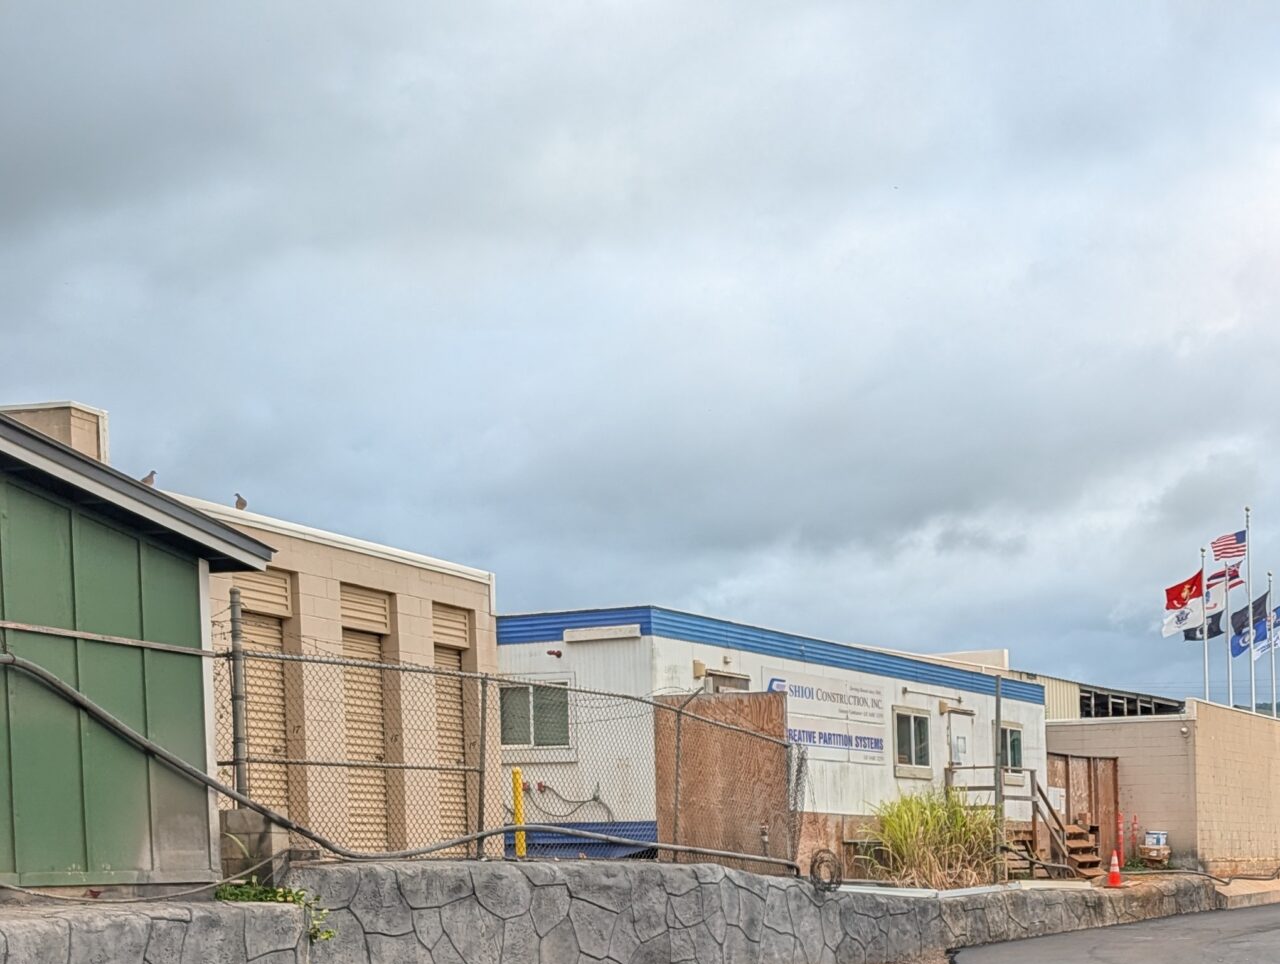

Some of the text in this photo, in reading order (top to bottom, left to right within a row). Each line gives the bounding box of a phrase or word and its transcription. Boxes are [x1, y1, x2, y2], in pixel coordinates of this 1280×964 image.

[788, 684, 814, 700] SHIOI
[788, 729, 884, 751] REATIVE PARTITION SYSTEMS
